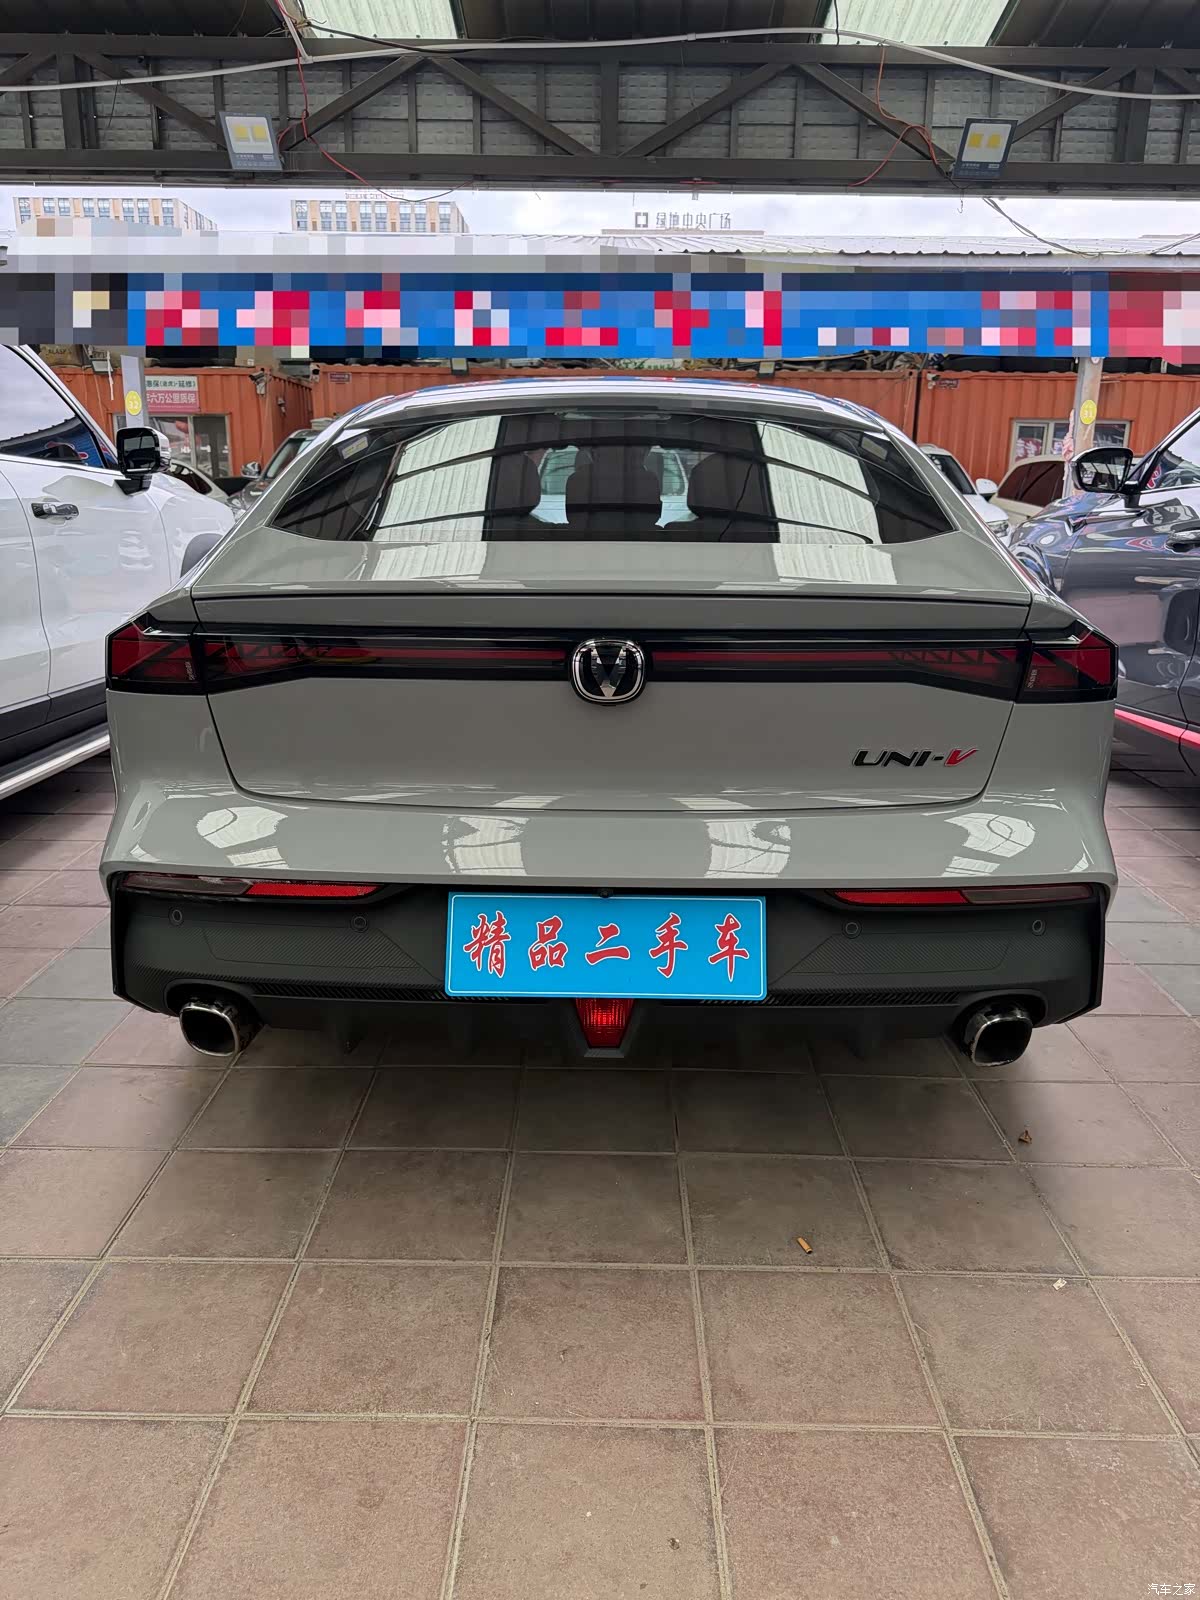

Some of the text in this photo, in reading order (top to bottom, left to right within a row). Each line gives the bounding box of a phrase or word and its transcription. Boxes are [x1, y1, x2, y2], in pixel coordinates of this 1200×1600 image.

[656, 212, 731, 229] 绿地中央广场
[852, 748, 979, 767] UNI-V
[463, 910, 750, 983] 精品二手车
